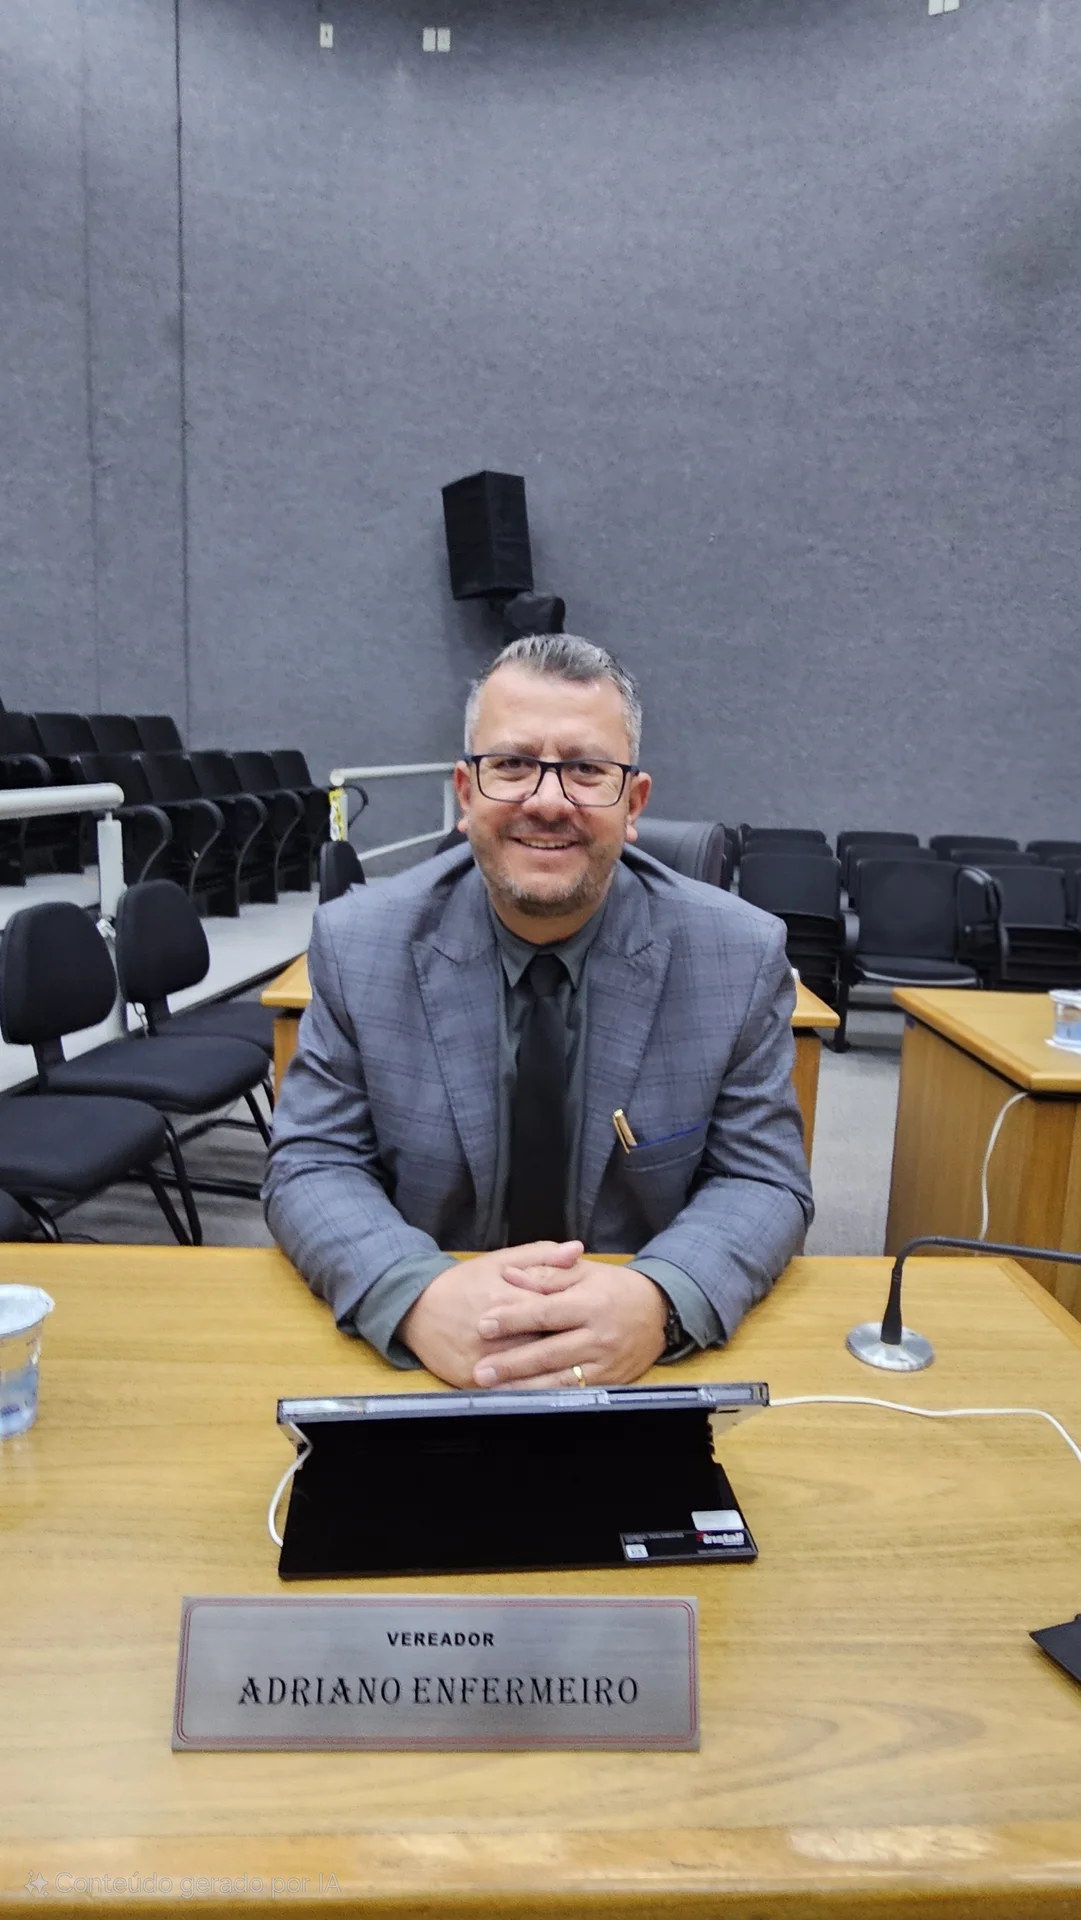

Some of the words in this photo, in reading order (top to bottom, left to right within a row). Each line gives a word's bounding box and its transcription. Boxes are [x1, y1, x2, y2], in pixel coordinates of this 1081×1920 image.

[387, 1631, 495, 1647] VEREADOR
[239, 1676, 401, 1705] ADRIANO
[413, 1676, 640, 1705] ENFERMEIRO
